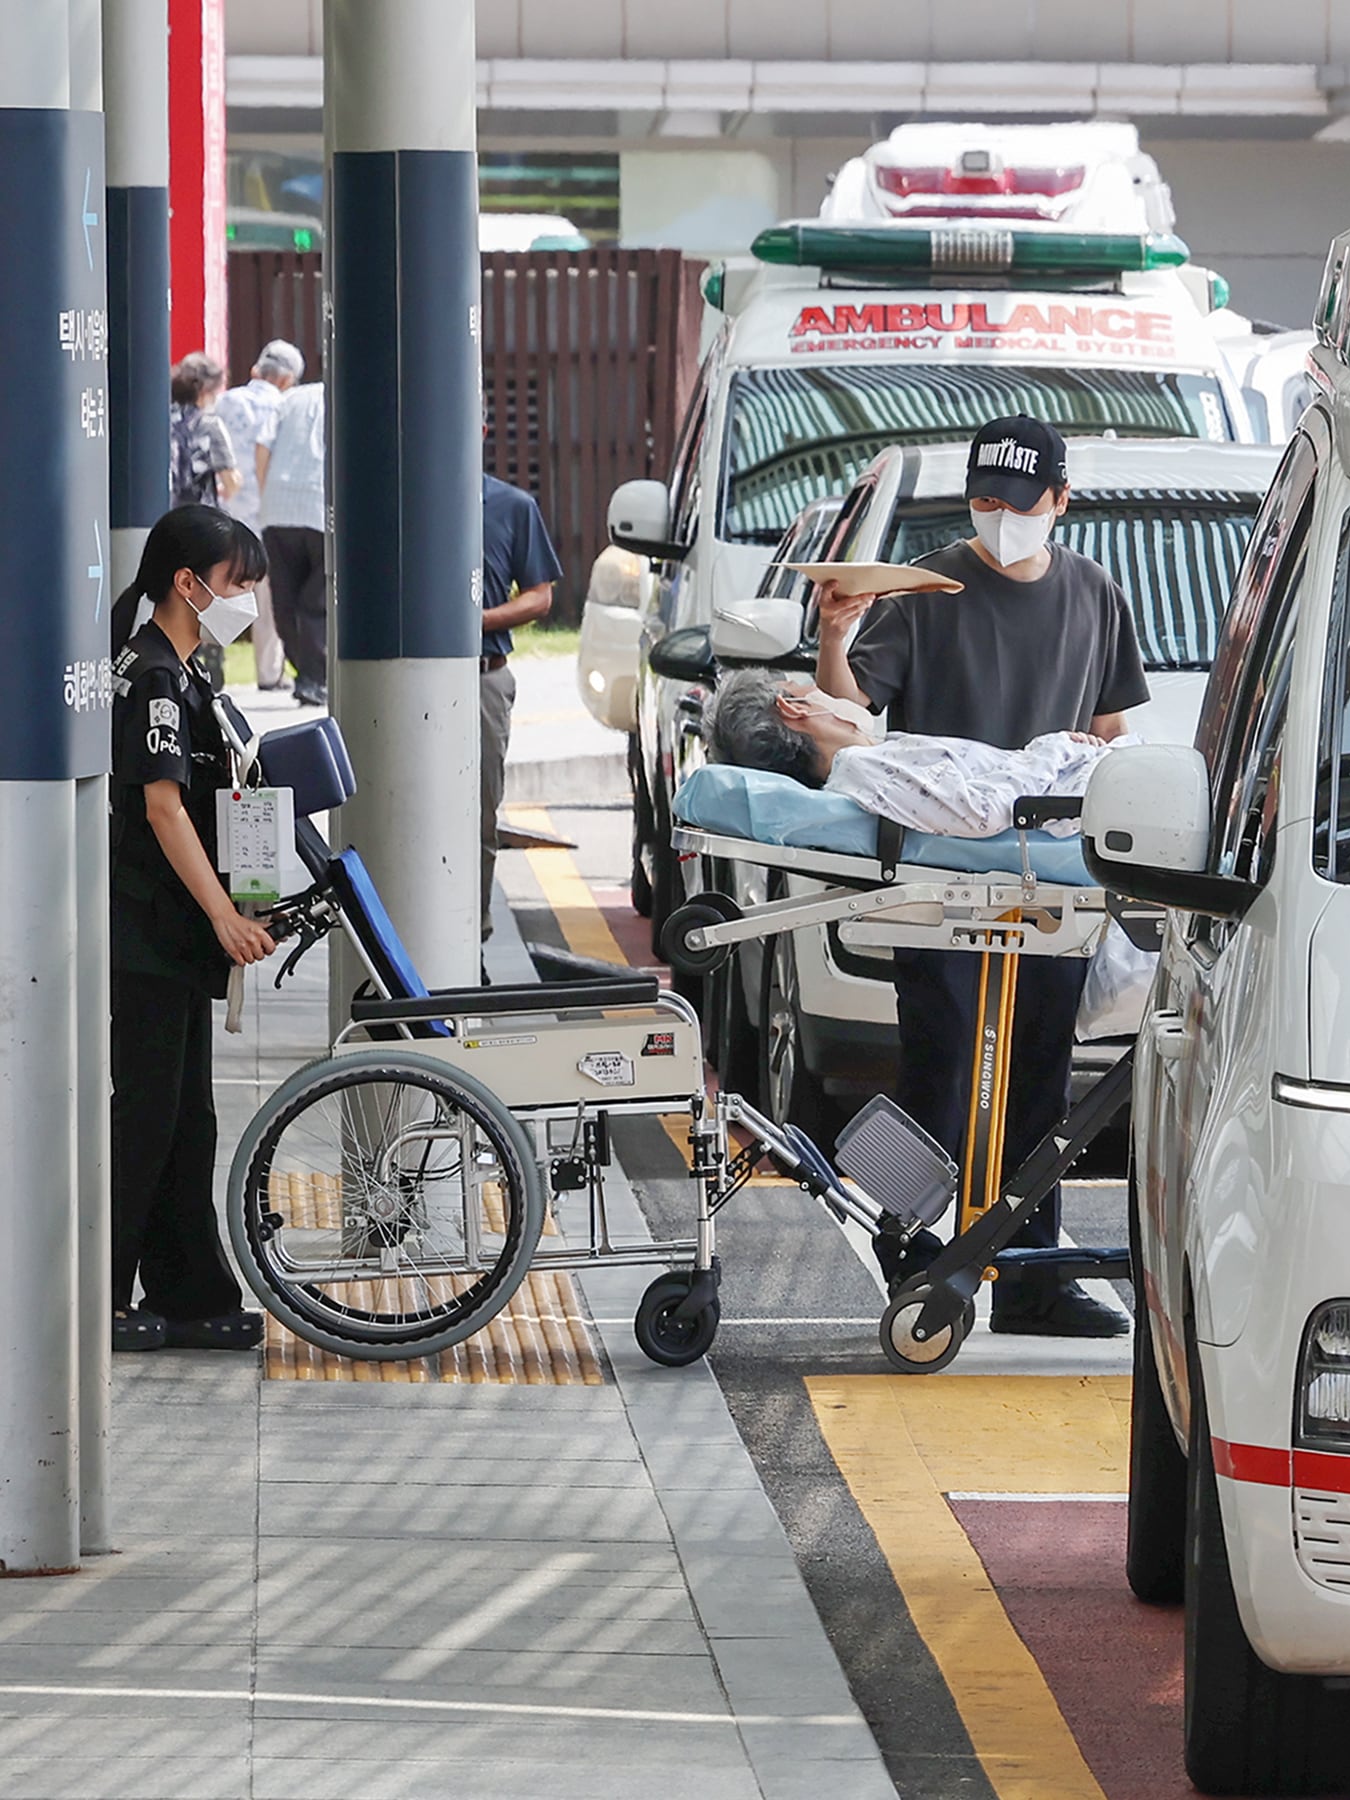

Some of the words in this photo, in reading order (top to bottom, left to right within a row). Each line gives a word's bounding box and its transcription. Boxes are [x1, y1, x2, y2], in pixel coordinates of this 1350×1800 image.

[788, 303, 1173, 343] AMBULANCE
[791, 336, 942, 353] EMERGENCY
[954, 336, 1065, 352] MEDICAL
[1076, 340, 1176, 358] SYSTEM
[980, 1044, 994, 1109] SUNGWOO
